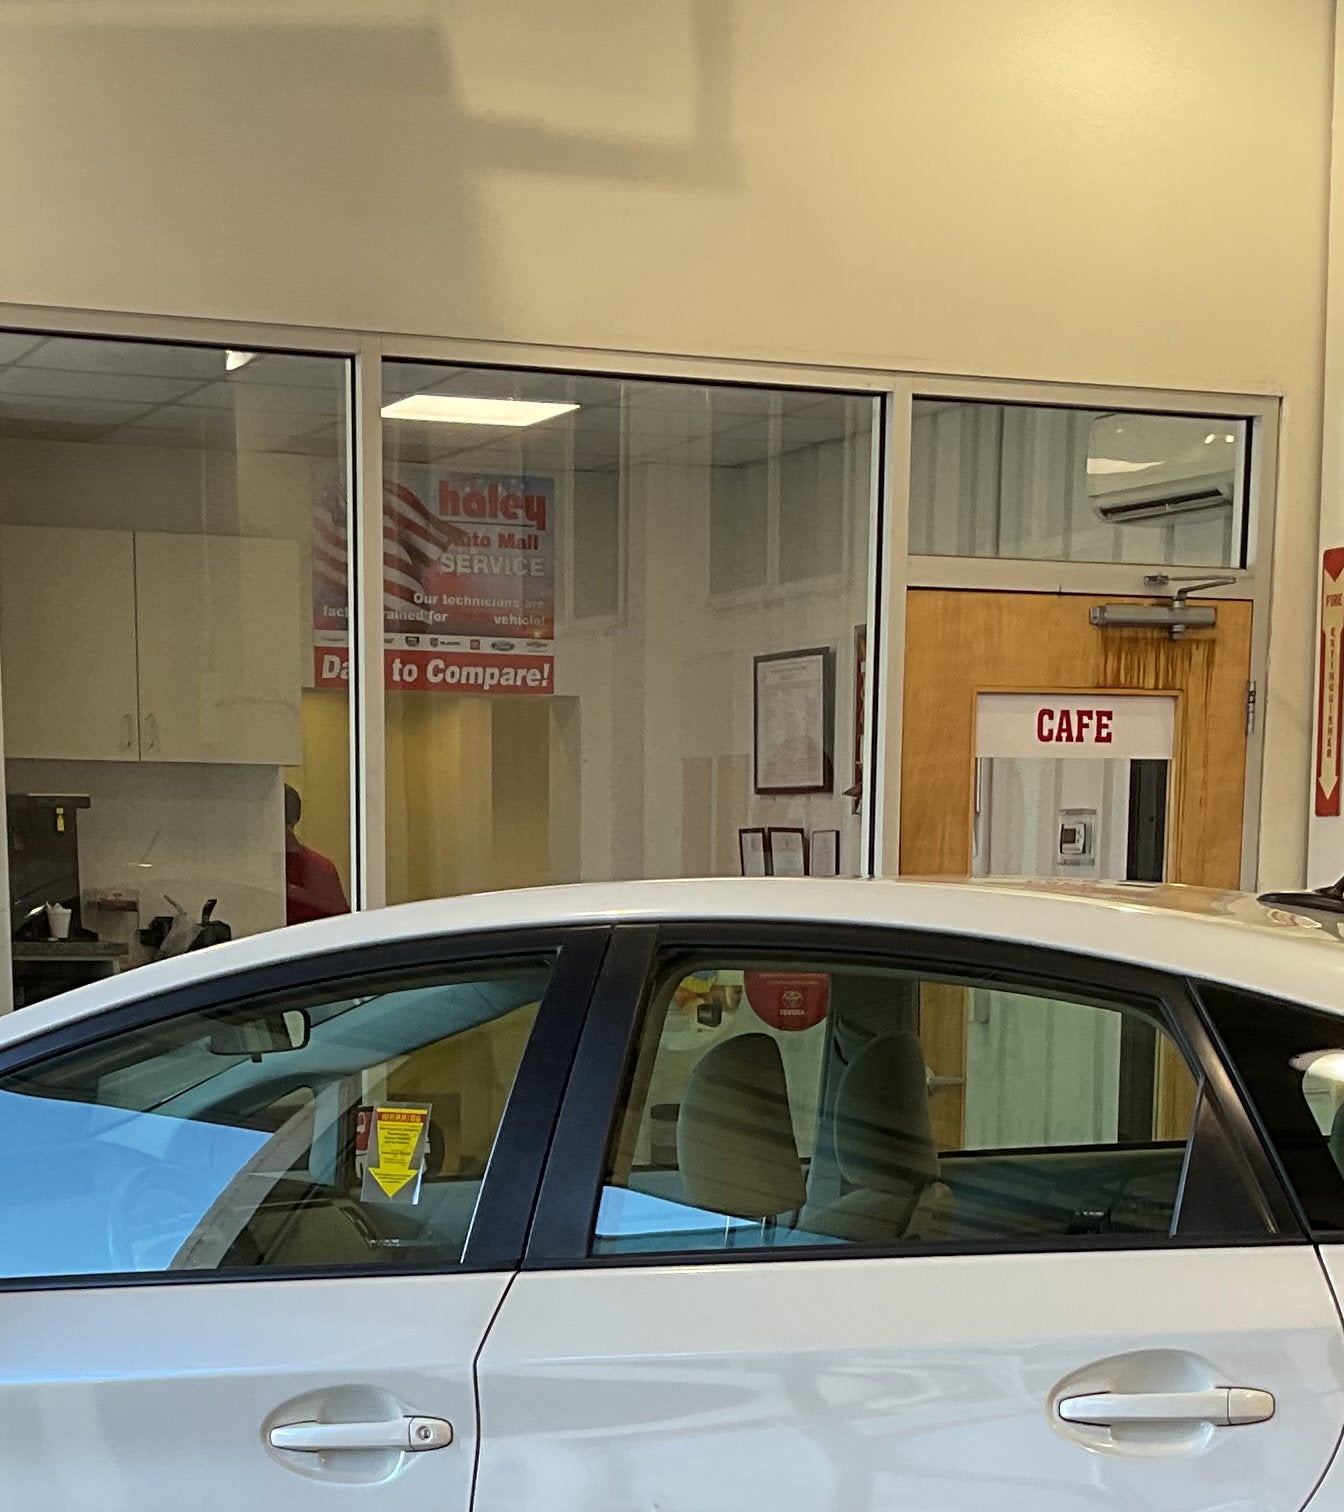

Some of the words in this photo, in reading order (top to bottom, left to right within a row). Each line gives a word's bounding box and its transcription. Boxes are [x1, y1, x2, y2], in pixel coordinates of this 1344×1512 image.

[439, 480, 546, 531] haley
[447, 531, 490, 548] Auto
[498, 532, 539, 550] Mall
[439, 552, 545, 576] SERVICE
[413, 592, 438, 604] Our
[442, 593, 521, 608] technicians
[1326, 593, 1343, 607] FIRE
[384, 608, 424, 622] rained
[427, 610, 449, 623] for
[494, 614, 545, 626] vehicle!
[392, 659, 418, 682] to
[426, 658, 551, 690] Compare!
[1326, 626, 1336, 759] EXTINGUISHER
[1037, 708, 1113, 744] CAFE
